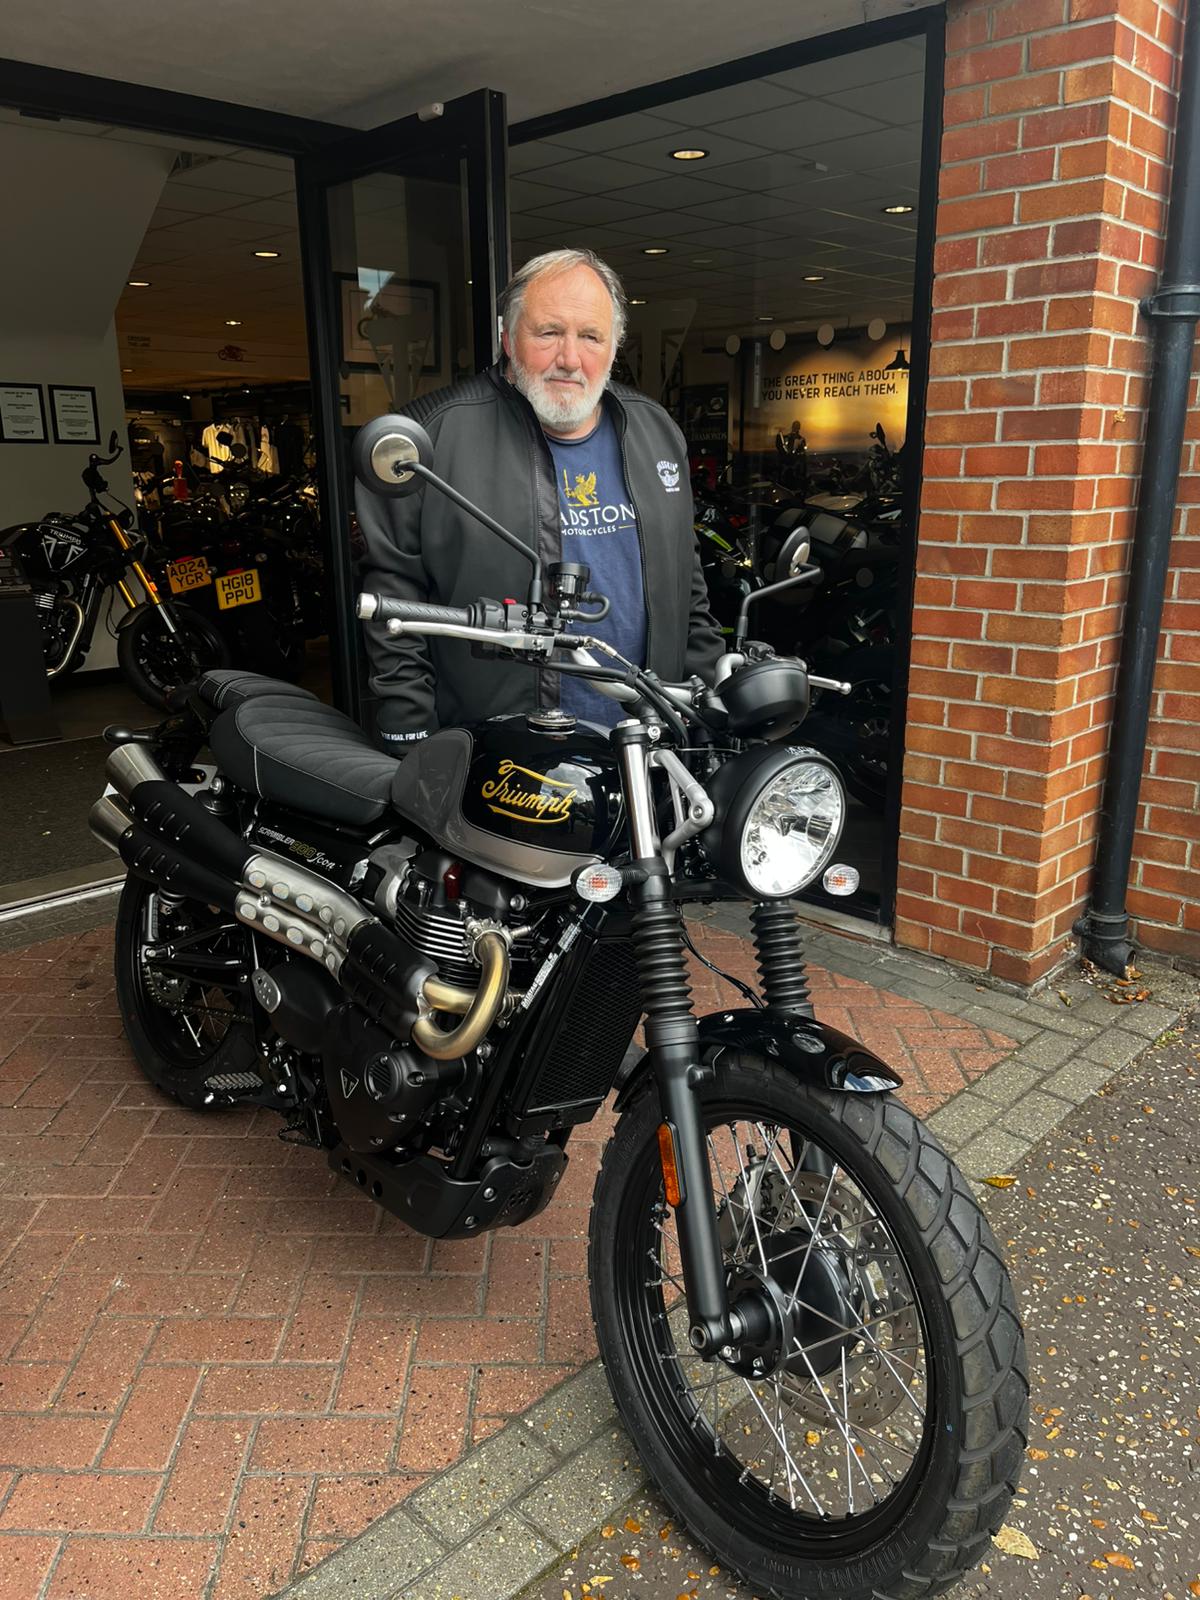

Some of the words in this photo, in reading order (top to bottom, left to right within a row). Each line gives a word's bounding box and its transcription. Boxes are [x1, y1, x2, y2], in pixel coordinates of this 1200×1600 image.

[762, 376, 781, 388] THE
[784, 375, 818, 387] GREAT
[822, 371, 855, 384] THING
[761, 389, 782, 401] YOU
[785, 387, 820, 400] NEVER
[824, 385, 860, 398] REACH
[864, 383, 899, 396] THEM.
[49, 528, 82, 546] TRIUMPH
[561, 525, 617, 536] MOTORCYCLES
[176, 571, 205, 588] YGR
[221, 573, 254, 592] HG18
[225, 586, 255, 605] PPU
[481, 759, 578, 824] Triumph
[257, 826, 296, 846] SCRAMBLER
[288, 840, 317, 859] 900
[306, 851, 337, 869] Icon
